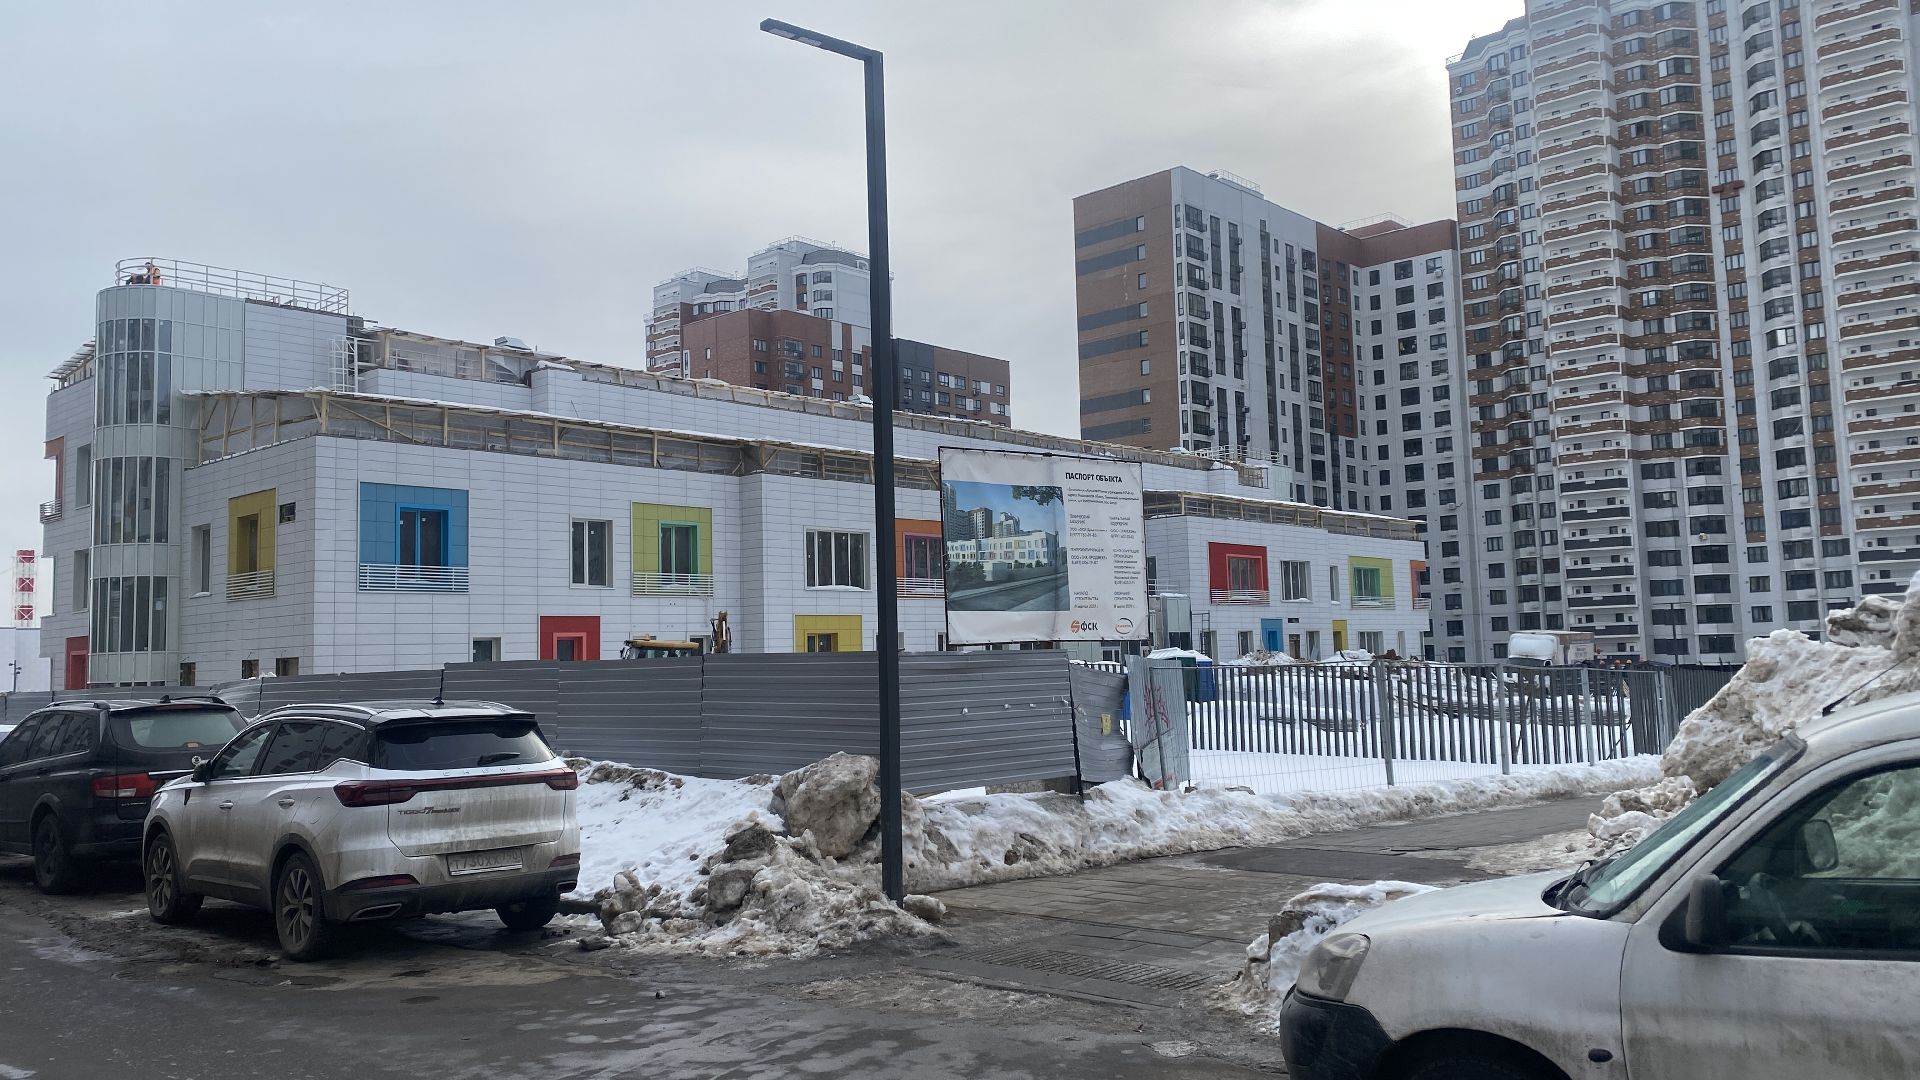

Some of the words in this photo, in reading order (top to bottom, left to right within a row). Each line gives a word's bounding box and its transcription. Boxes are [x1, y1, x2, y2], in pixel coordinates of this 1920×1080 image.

[1065, 472, 1095, 481] ПАСПОРТ
[1096, 474, 1122, 483] ОБЪЕКТА
[1080, 621, 1098, 632] ФСК
